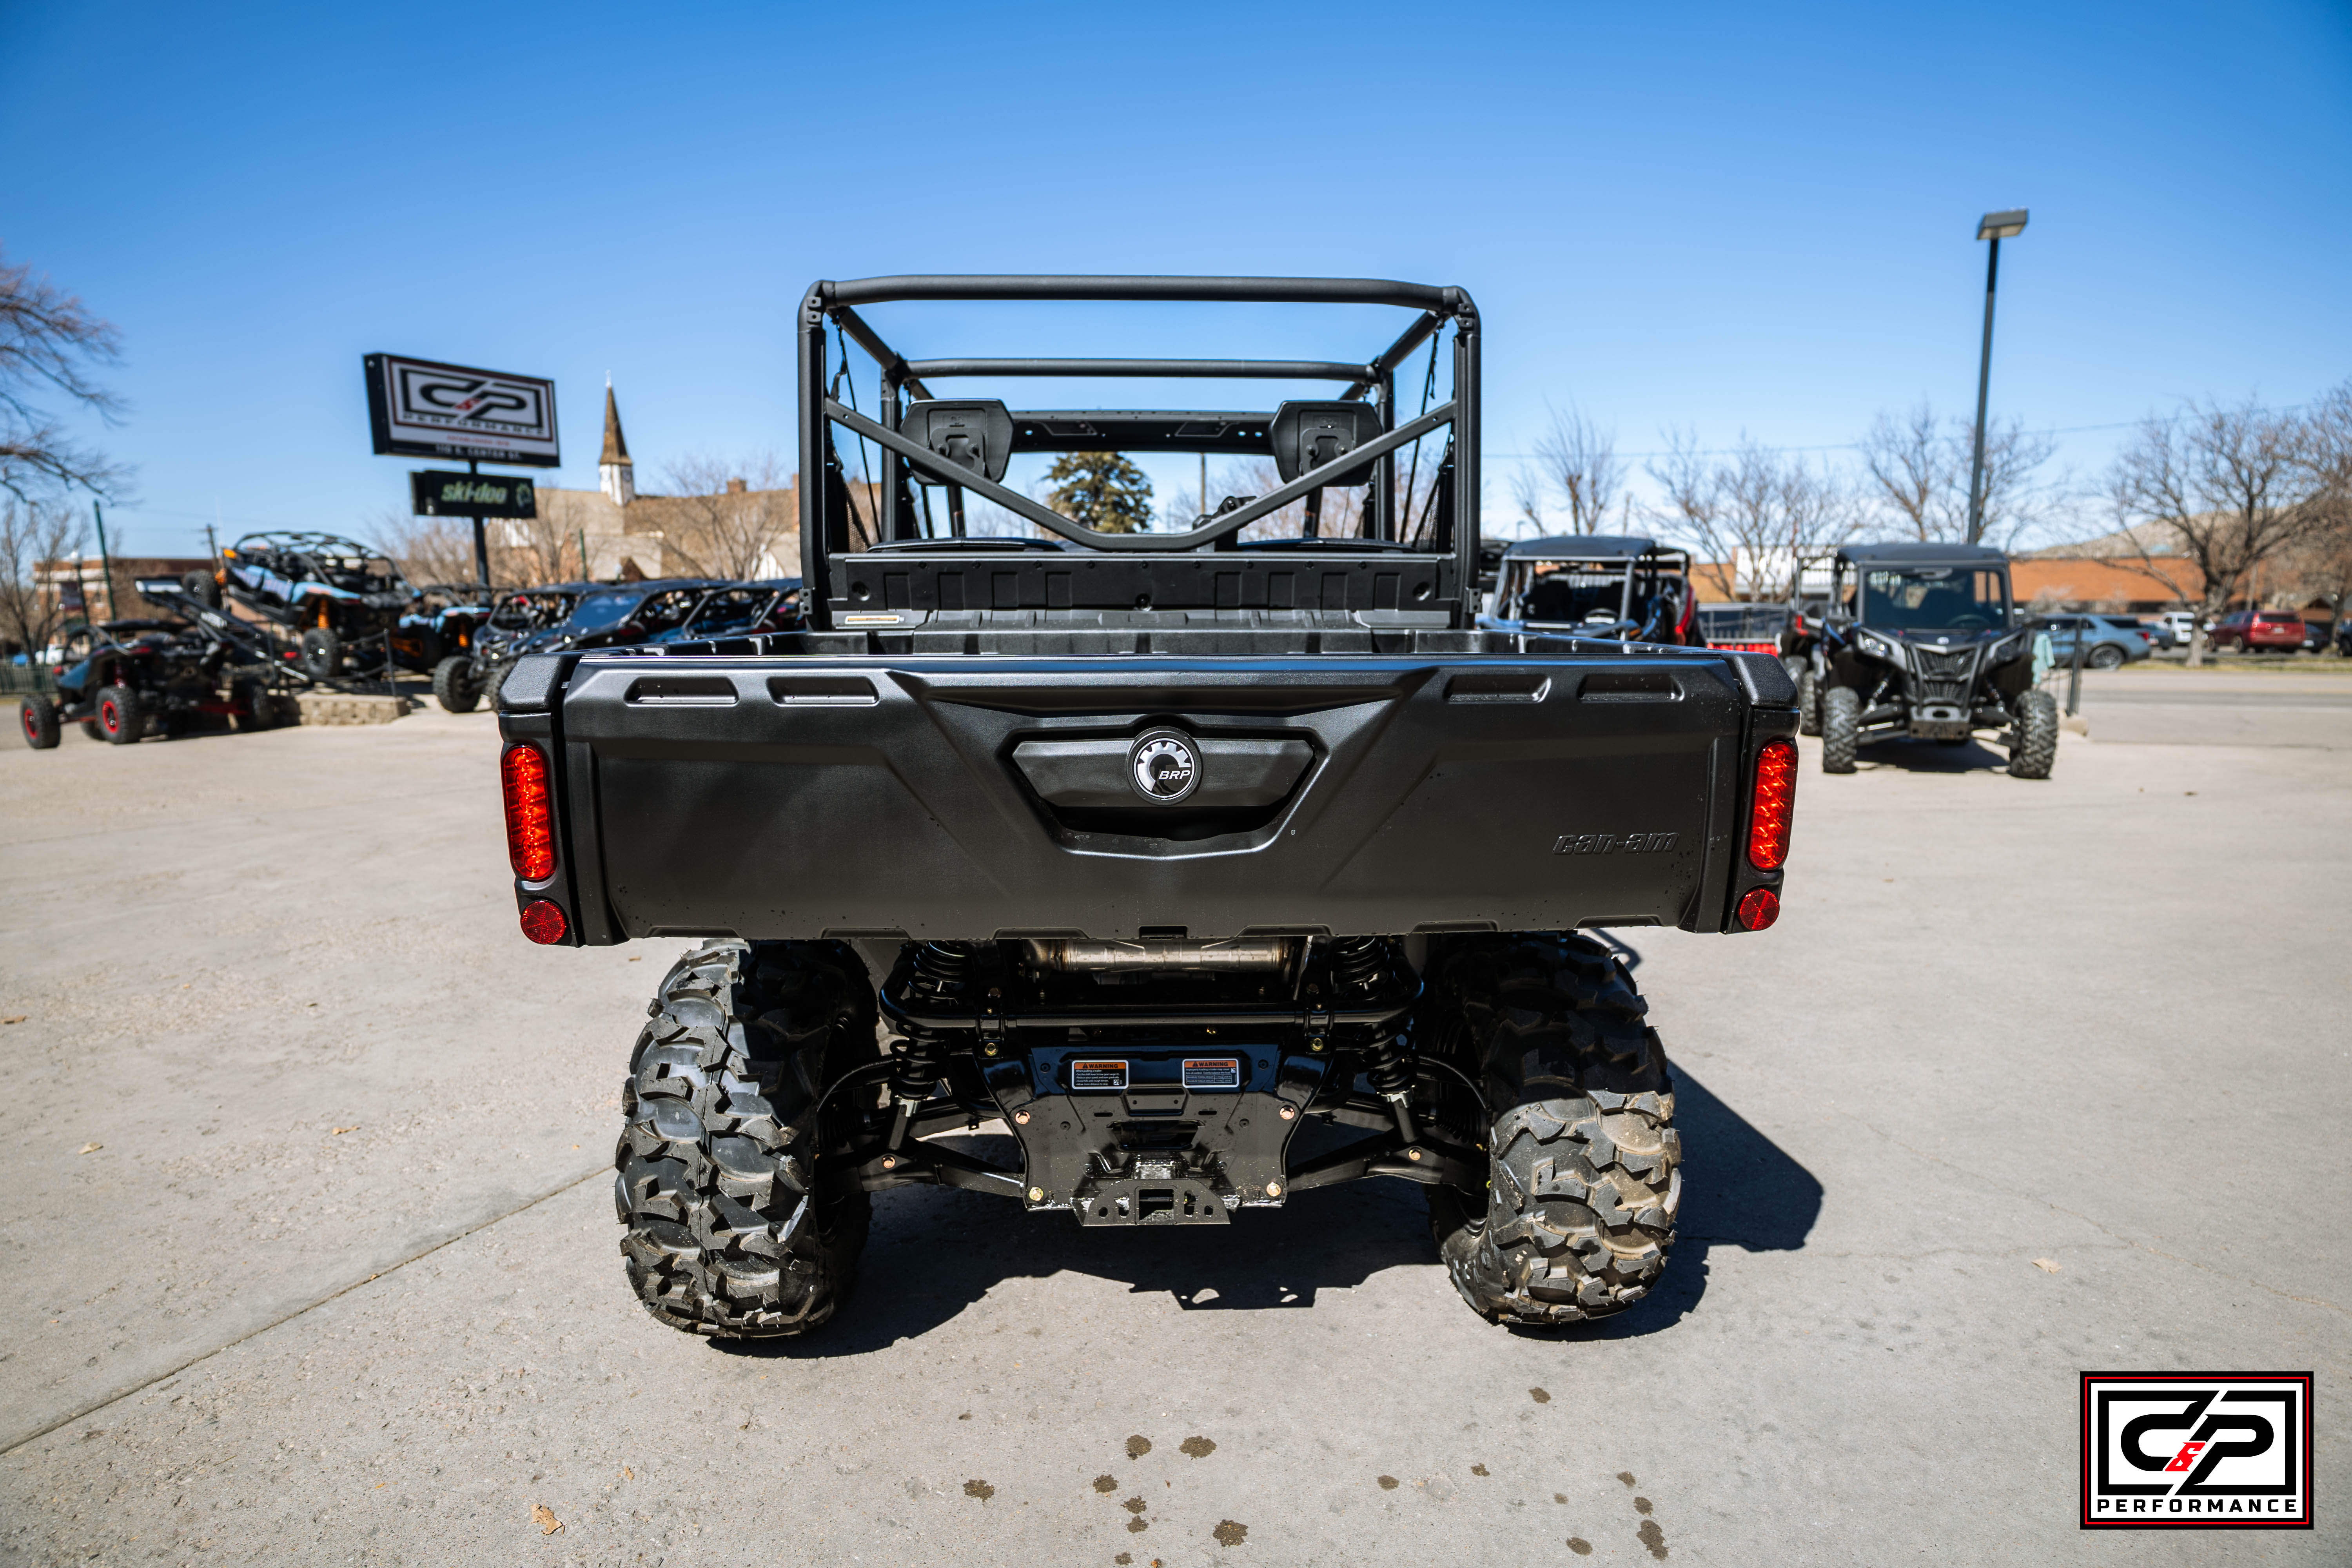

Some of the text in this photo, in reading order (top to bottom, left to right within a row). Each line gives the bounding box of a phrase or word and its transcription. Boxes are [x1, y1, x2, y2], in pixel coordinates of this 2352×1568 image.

[403, 412, 543, 436] PERFORMANCE
[467, 447, 505, 459] CENTER
[441, 480, 507, 505] ski-doo
[1158, 770, 1191, 780] BRP
[1553, 832, 1679, 855] can-am
